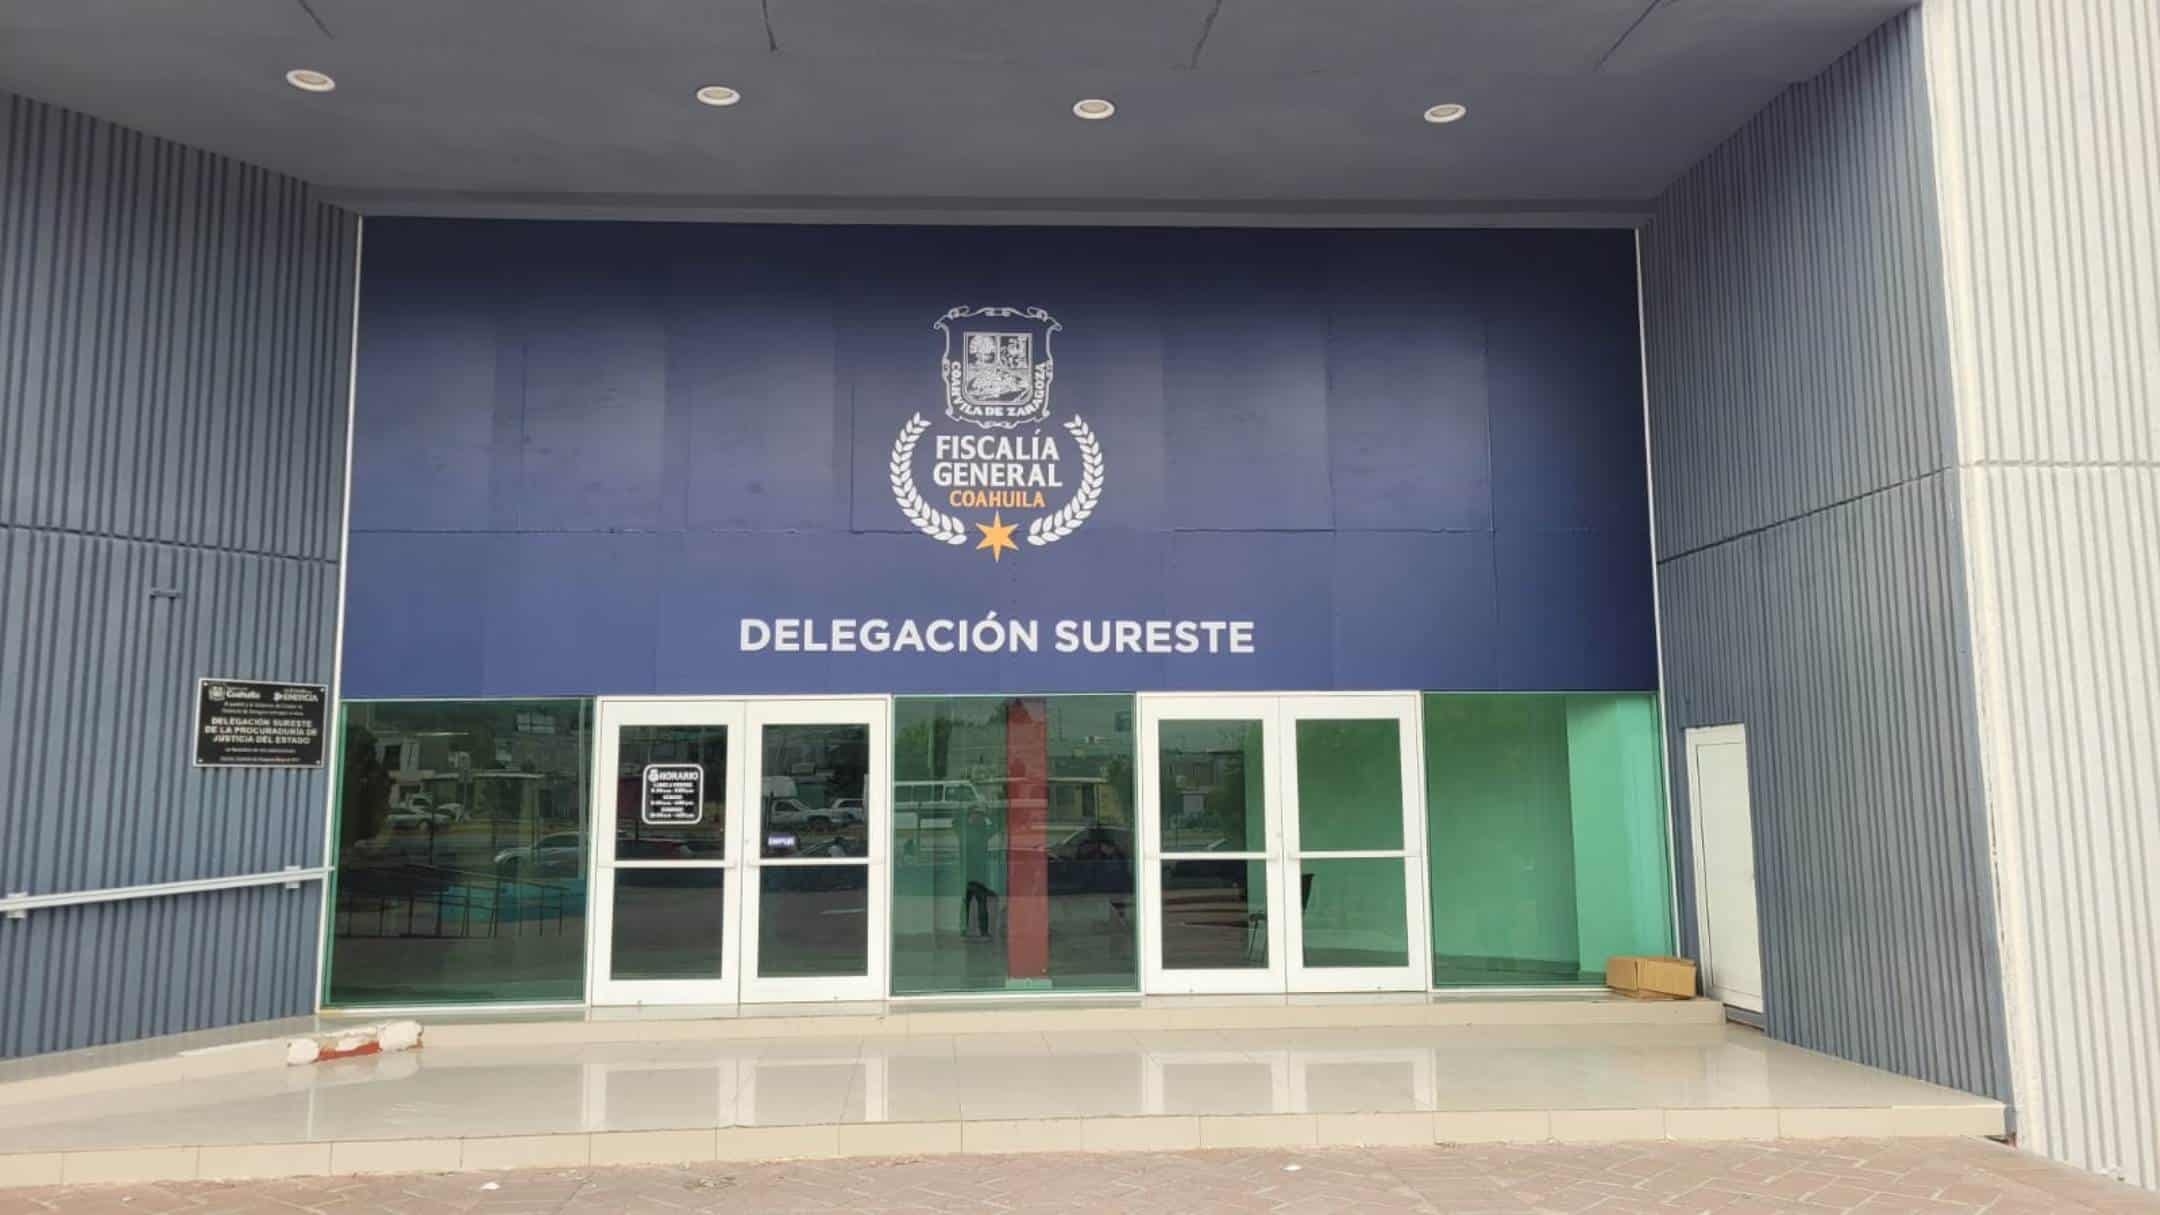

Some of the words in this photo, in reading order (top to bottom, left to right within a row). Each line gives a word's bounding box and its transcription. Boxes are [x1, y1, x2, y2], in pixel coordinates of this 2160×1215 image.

[985, 406, 1003, 417] DE
[1006, 362, 1046, 417] ZARAGOZA
[936, 428, 1060, 460] FISCALÍA
[933, 462, 1063, 487] GENERAL
[950, 490, 1046, 507] COAHUILA
[740, 611, 1038, 653] DELEGACIÓN
[1055, 620, 1255, 653] SURESTE
[204, 725, 217, 734] DE
[220, 726, 232, 734] LA
[211, 717, 270, 726] DELEGACIÓN
[273, 719, 313, 727] SURESTE
[213, 735, 254, 743] JUSTICIA
[256, 736, 274, 744] DEL
[276, 737, 311, 745] ESTADO
